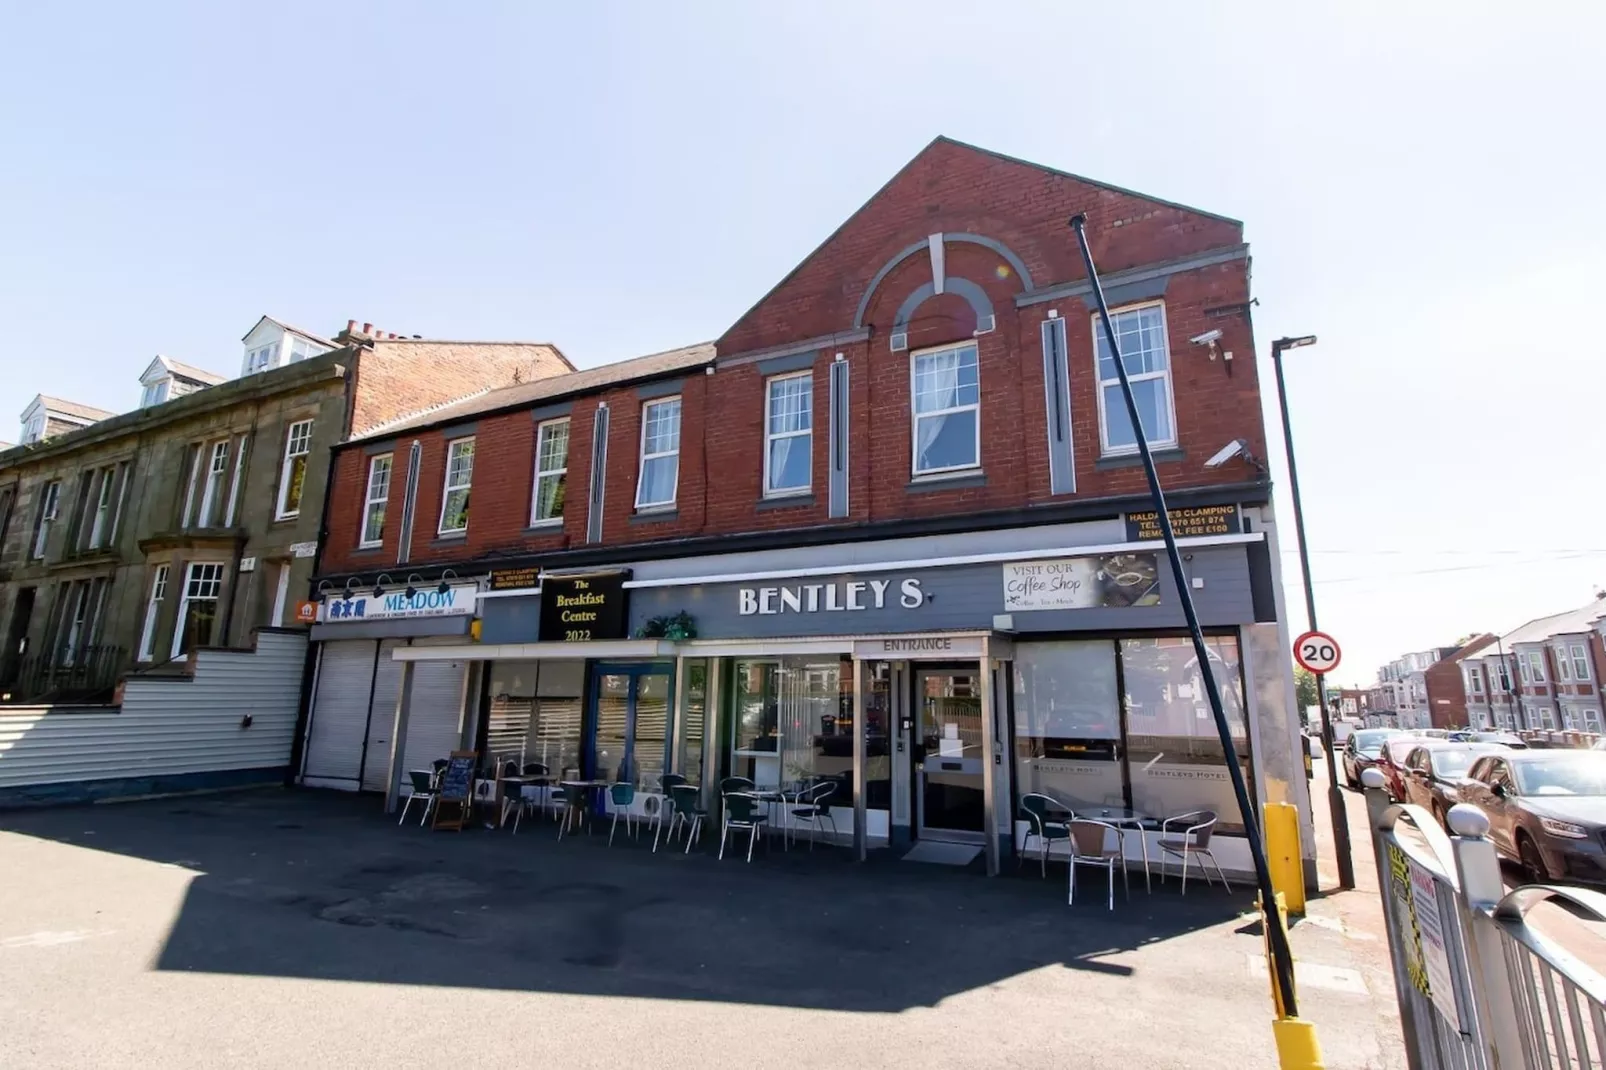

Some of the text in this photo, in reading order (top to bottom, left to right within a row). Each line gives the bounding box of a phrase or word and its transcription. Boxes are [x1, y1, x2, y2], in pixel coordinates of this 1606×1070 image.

[1129, 506, 1234, 522] HALDAE'S CLAMPING
[1139, 529, 1183, 538] REMOAL
[1185, 526, 1204, 535] FEE
[1012, 563, 1073, 576] VISIT OUR
[574, 580, 589, 589] The
[1007, 574, 1081, 596] Coffee Shop
[383, 589, 458, 611] MEADOW
[556, 592, 605, 607] Breakfast
[561, 610, 597, 622] Centre
[565, 630, 591, 641] 2022
[883, 637, 951, 651] ENTRANCE
[1303, 645, 1335, 661] 20
